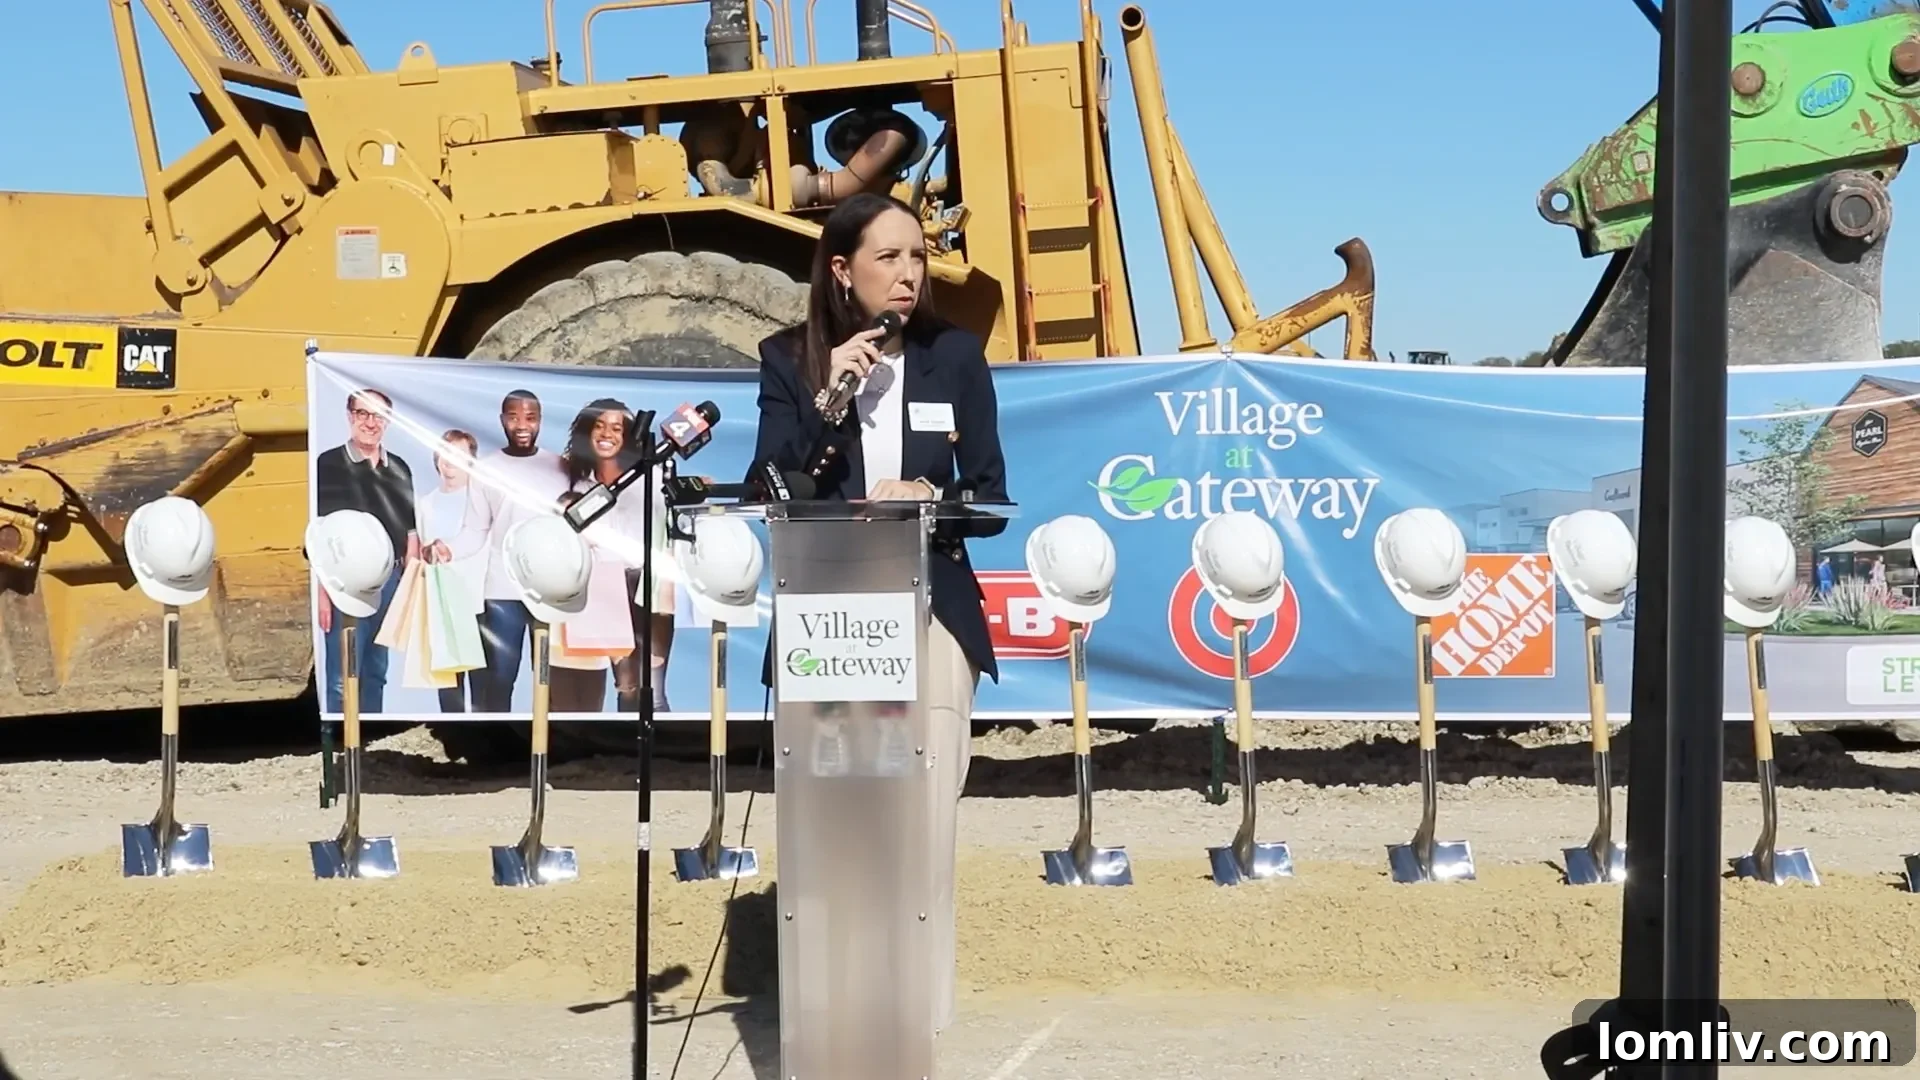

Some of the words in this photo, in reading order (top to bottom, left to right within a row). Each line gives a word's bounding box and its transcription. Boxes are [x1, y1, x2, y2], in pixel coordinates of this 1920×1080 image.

[123, 344, 169, 372] CAT
[669, 422, 691, 438] 4
[1154, 387, 1324, 450] Village
[1855, 426, 1883, 439] PEARL
[1225, 445, 1253, 468] at
[1098, 454, 1380, 539] Gateway
[798, 611, 899, 647] Village
[1432, 555, 1554, 676] HOME
[845, 644, 857, 654] at
[1477, 599, 1554, 676] DEPOT
[786, 647, 912, 684] Gateway
